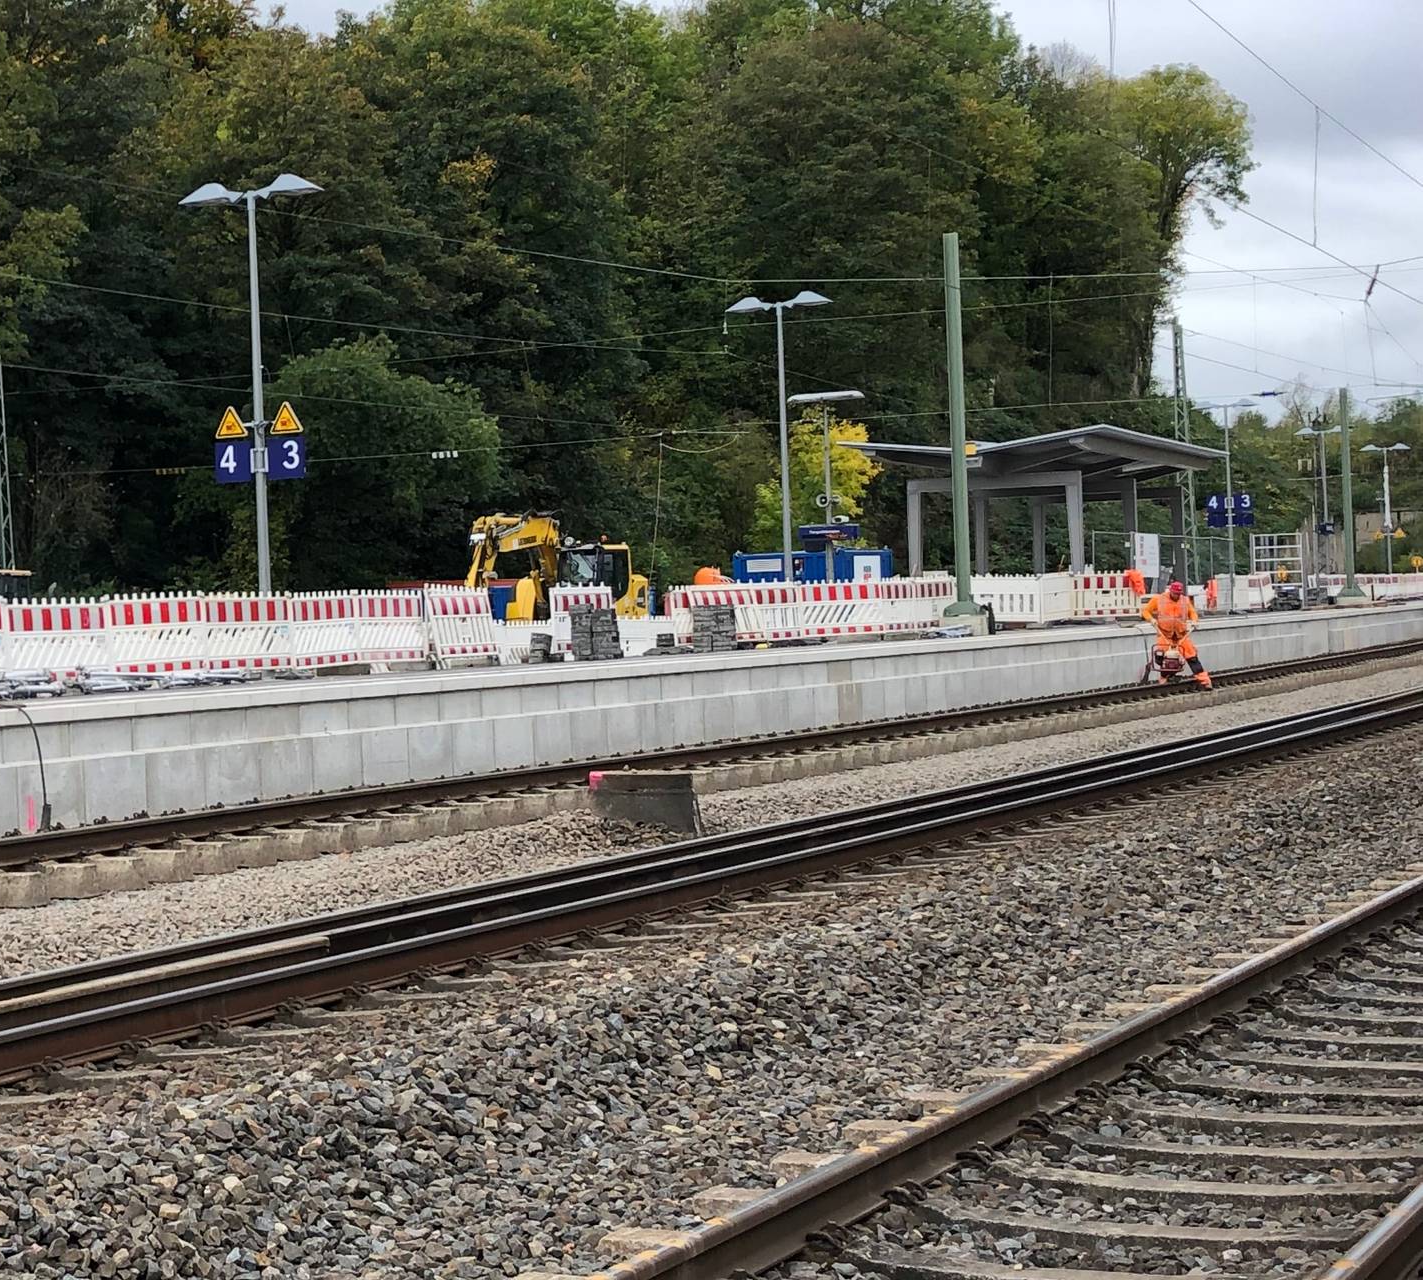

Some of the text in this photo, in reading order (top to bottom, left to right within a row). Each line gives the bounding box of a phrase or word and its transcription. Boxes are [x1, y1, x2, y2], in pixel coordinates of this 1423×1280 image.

[220, 445, 237, 474] 4
[282, 440, 300, 469] 3
[1208, 496, 1218, 509] 4
[1241, 494, 1251, 508] 3
